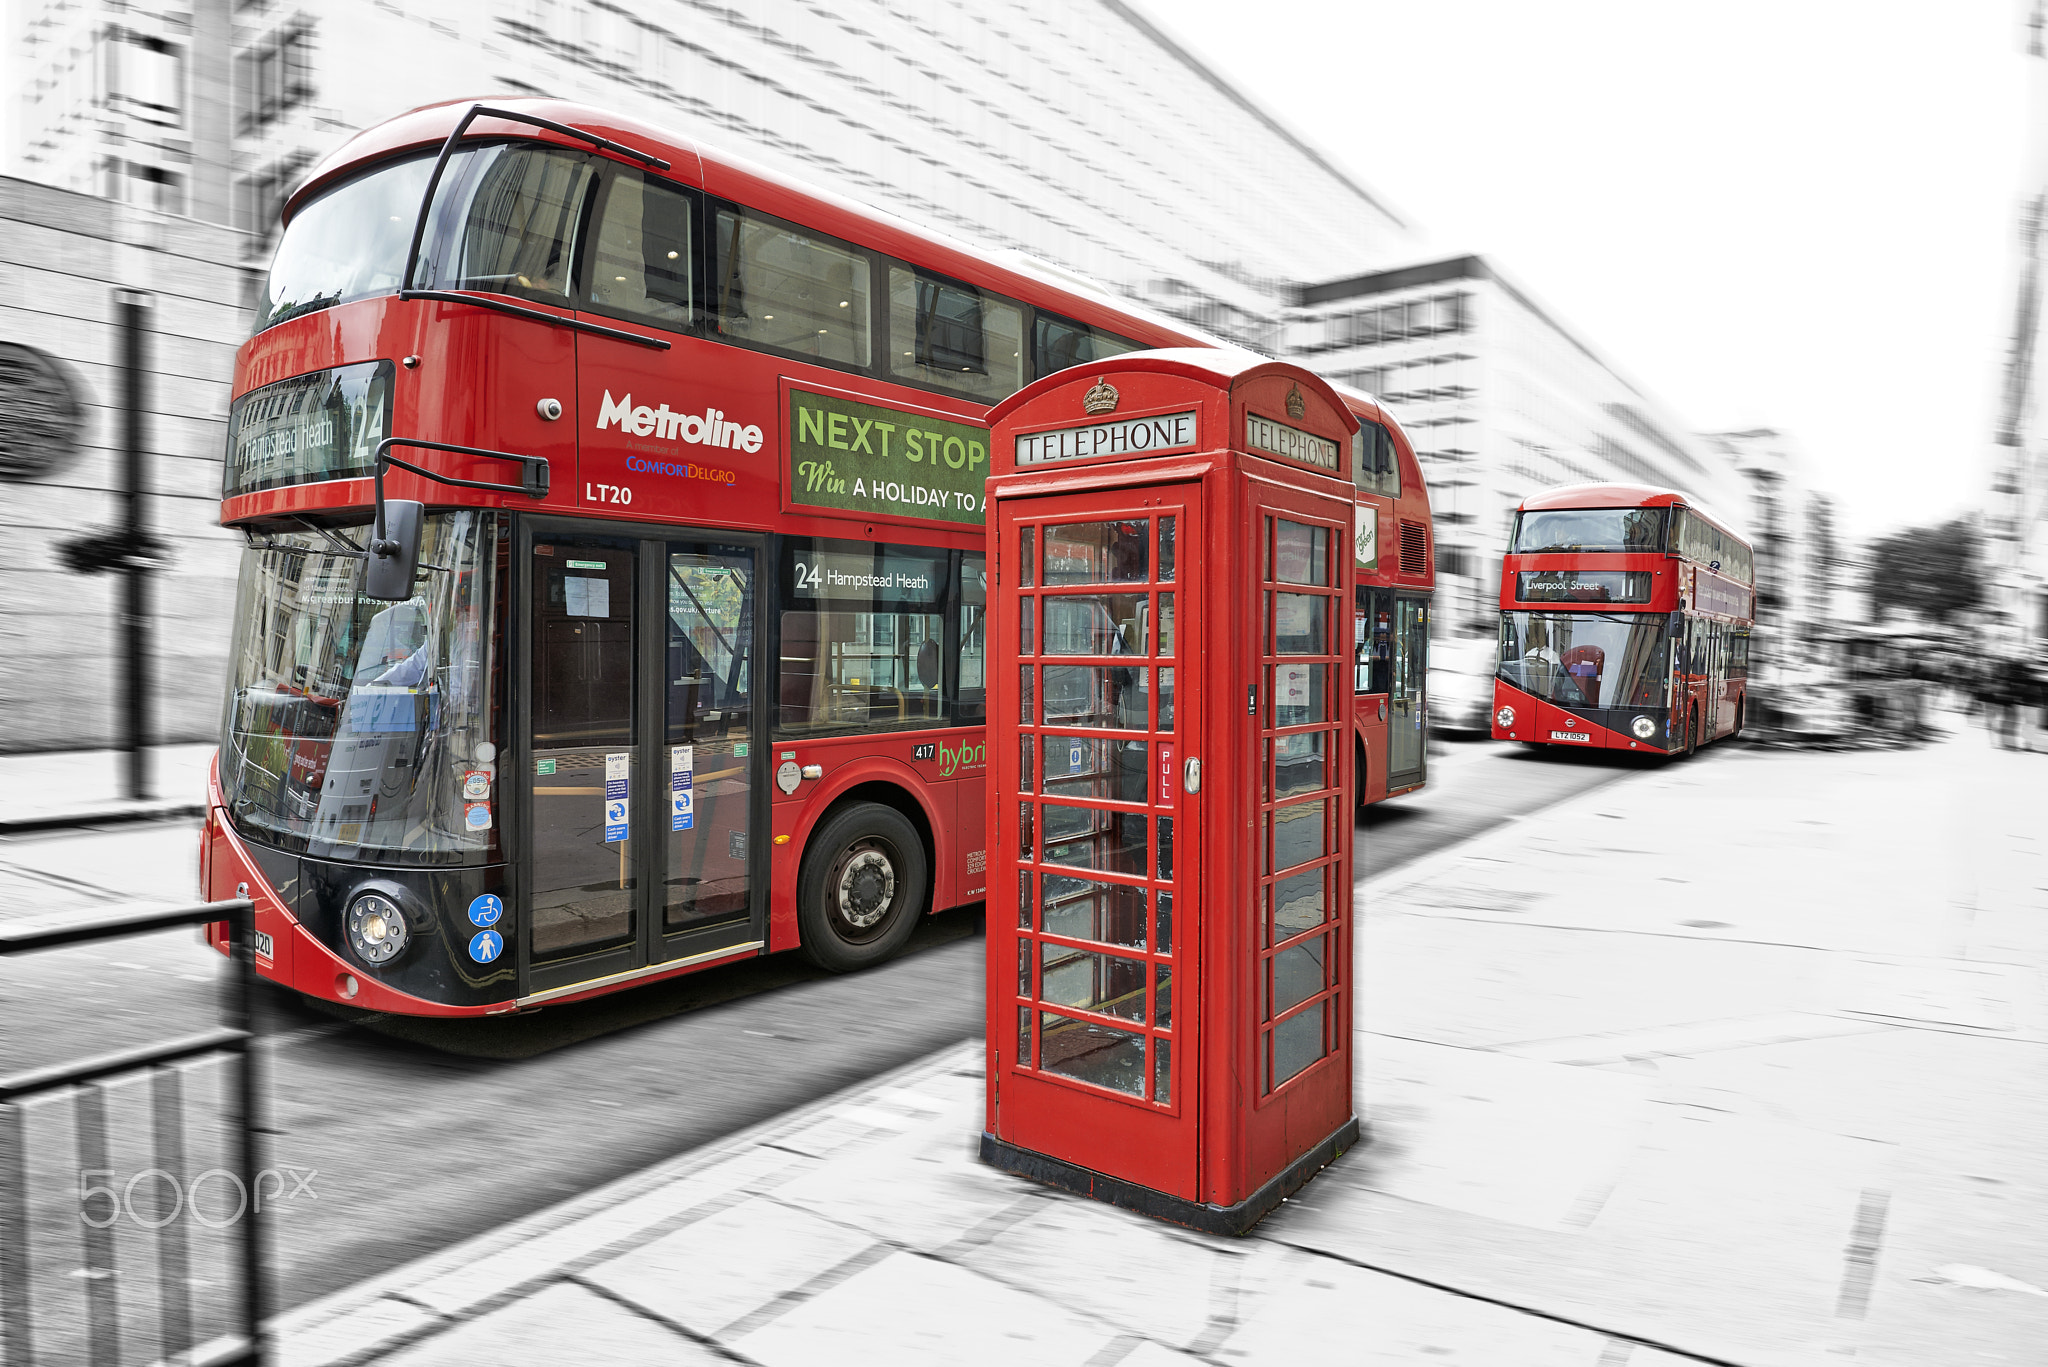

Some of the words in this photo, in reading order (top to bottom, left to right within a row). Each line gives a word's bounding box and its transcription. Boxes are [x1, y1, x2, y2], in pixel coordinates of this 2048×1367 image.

[245, 417, 297, 467] Hampstead
[301, 410, 333, 450] Heath
[353, 390, 385, 459] 24
[596, 389, 764, 454] Metroline
[799, 406, 895, 457] NEXT
[905, 428, 985, 471] STOP
[1023, 417, 1189, 462] TELEPHONE
[1248, 419, 1335, 470] TELEPHONE
[586, 482, 632, 505] LT20
[798, 460, 846, 495] Win
[853, 478, 867, 498] A
[872, 480, 950, 508] HOLIDAY
[954, 492, 976, 512] TO
[795, 562, 823, 589] 24
[827, 569, 892, 591] Hampstead
[896, 573, 928, 589] Heath
[1526, 580, 1567, 592] Liverpool
[1570, 581, 1599, 591] Street
[608, 755, 626, 763] oyster
[915, 745, 934, 758] 417
[466, 771, 490, 780] WARNING
[1162, 751, 1170, 799] PULL
[466, 803, 490, 812] WARNING
